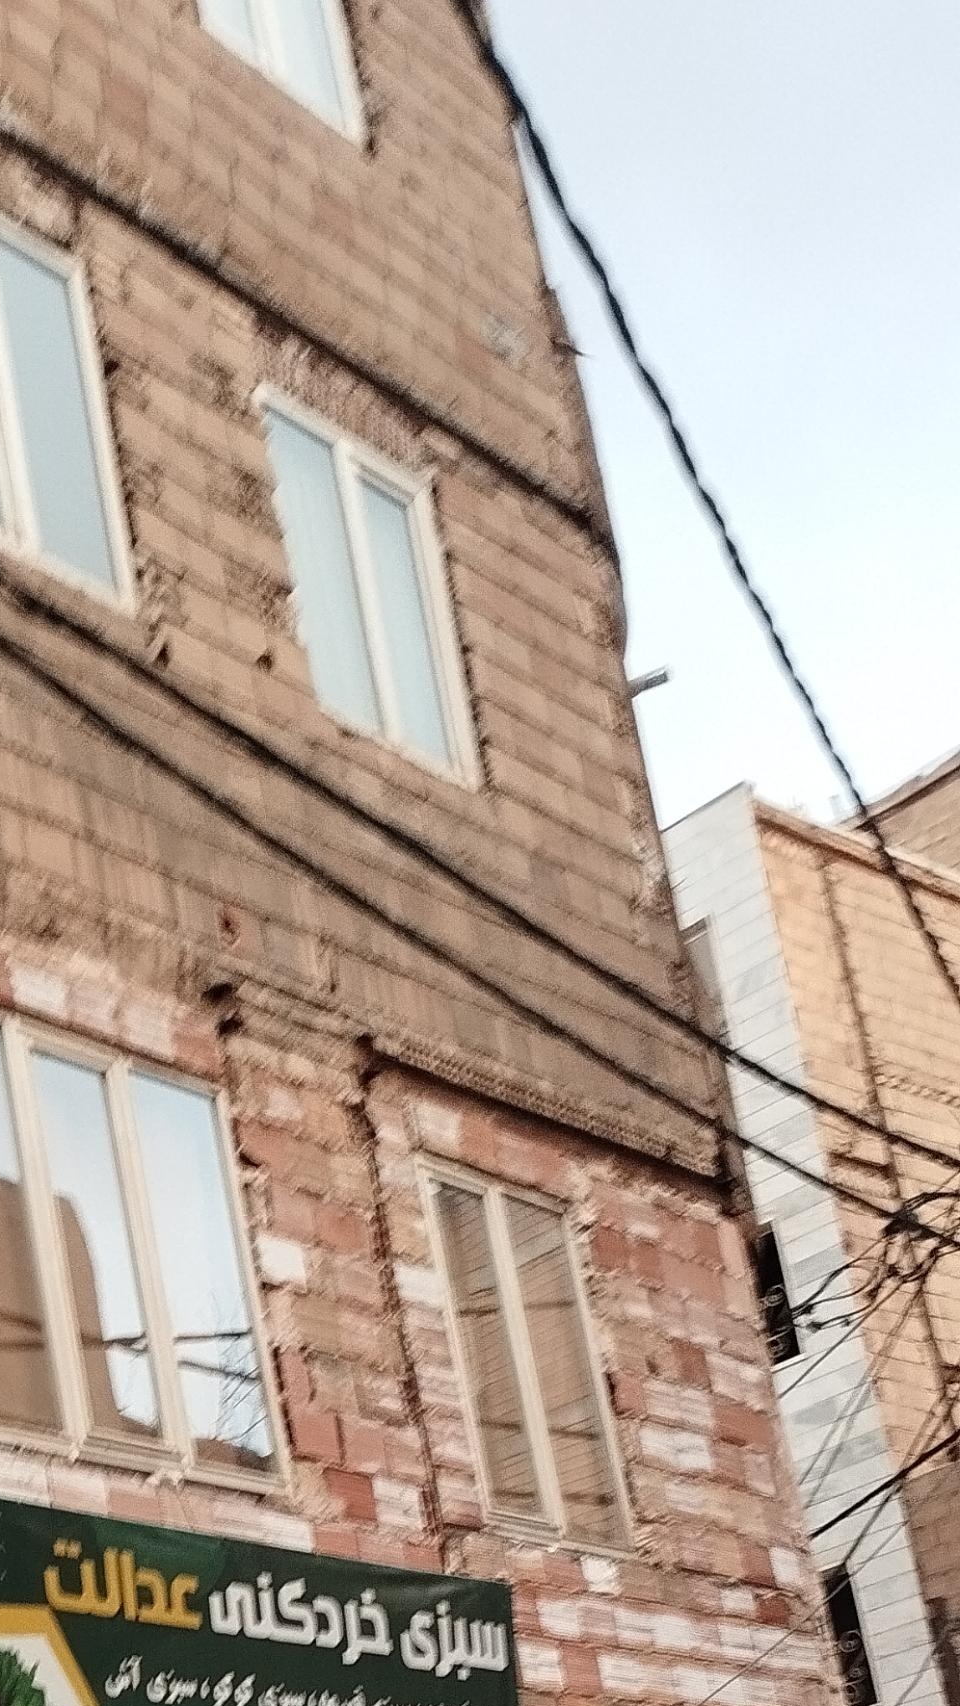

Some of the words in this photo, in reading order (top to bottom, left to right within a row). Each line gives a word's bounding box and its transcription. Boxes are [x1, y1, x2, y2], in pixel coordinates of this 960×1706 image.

[44, 1537, 204, 1631] عدالت
[208, 1570, 393, 1666] خردکنی
[400, 1600, 509, 1681] سبزی
